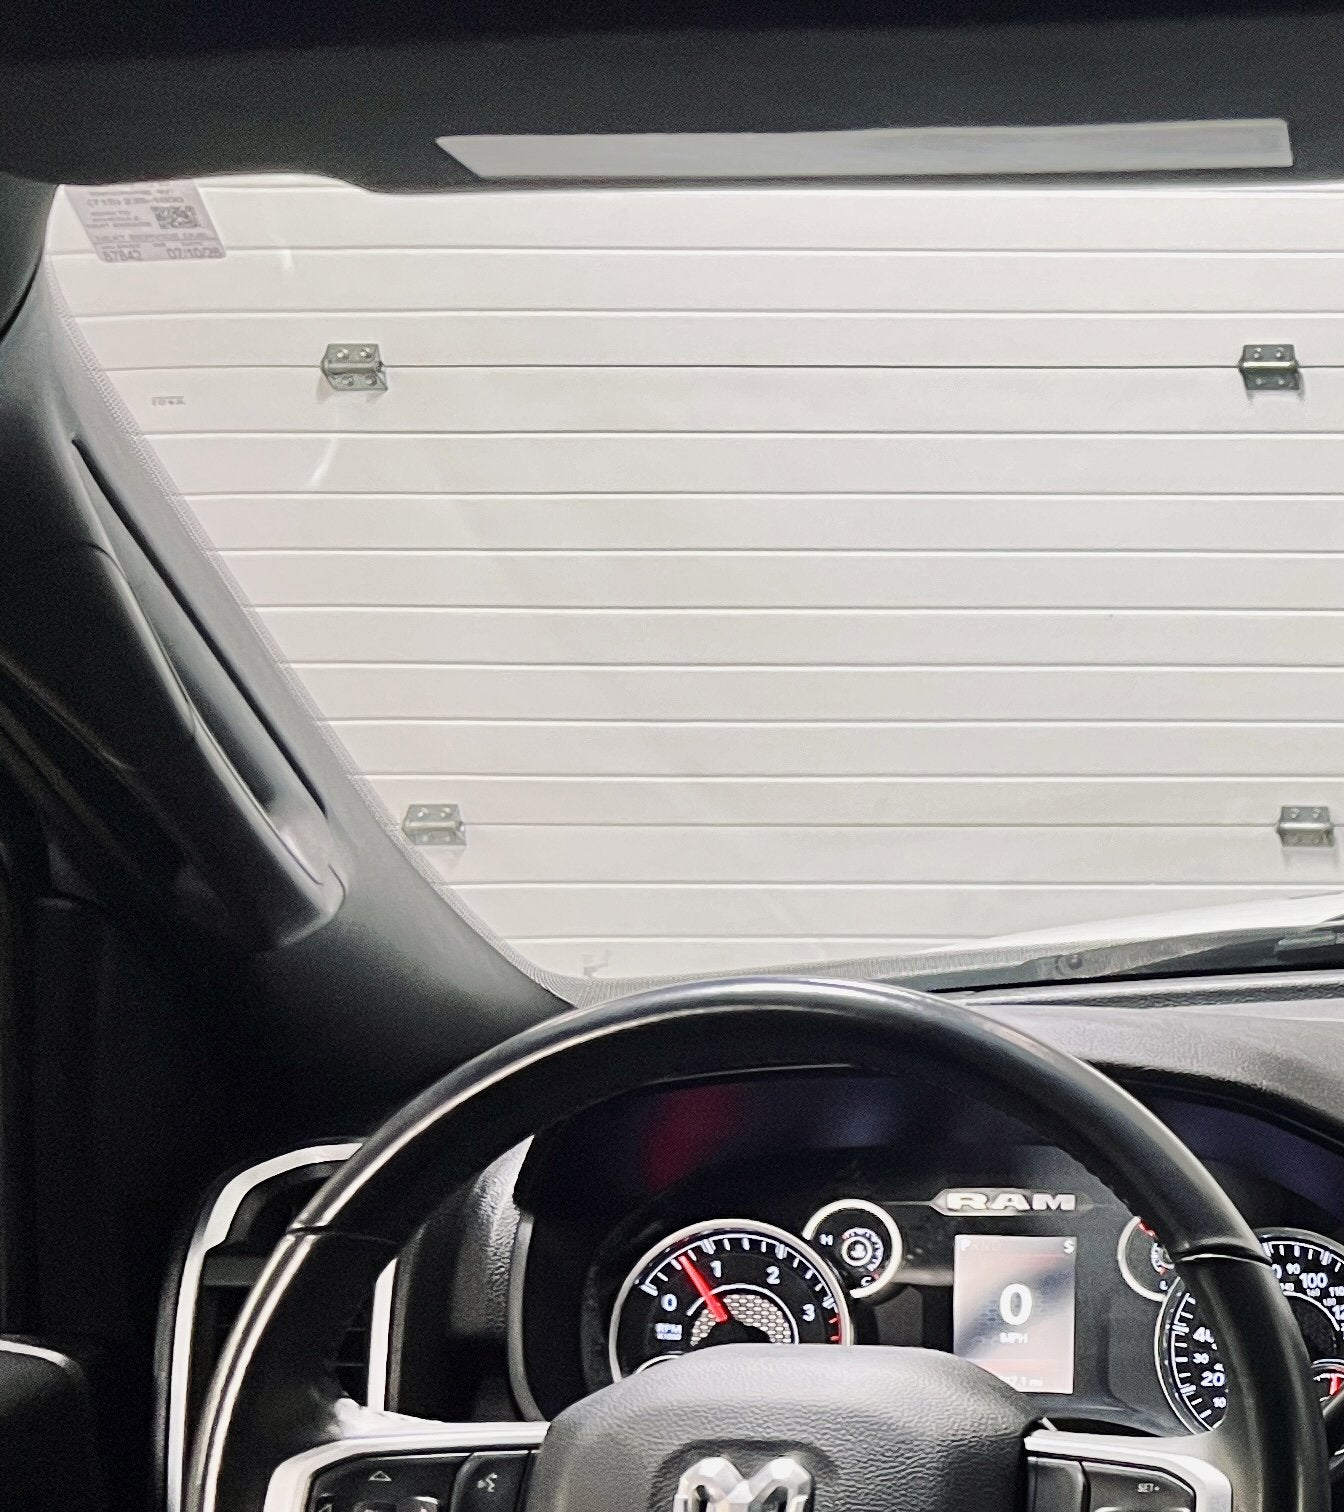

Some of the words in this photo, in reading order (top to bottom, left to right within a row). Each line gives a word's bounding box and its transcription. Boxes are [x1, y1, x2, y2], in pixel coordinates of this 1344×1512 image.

[946, 1193, 1076, 1211] RAM
[710, 1260, 723, 1278] 1
[766, 1265, 780, 1285] 2
[1286, 1263, 1301, 1275] 90
[1300, 1272, 1329, 1290] 100
[660, 1293, 677, 1312] 0
[1000, 1284, 1033, 1326] 0
[802, 1303, 815, 1322] 3
[999, 1332, 1029, 1344] MPH
[1193, 1352, 1209, 1365] 30
[1201, 1371, 1226, 1388] 20
